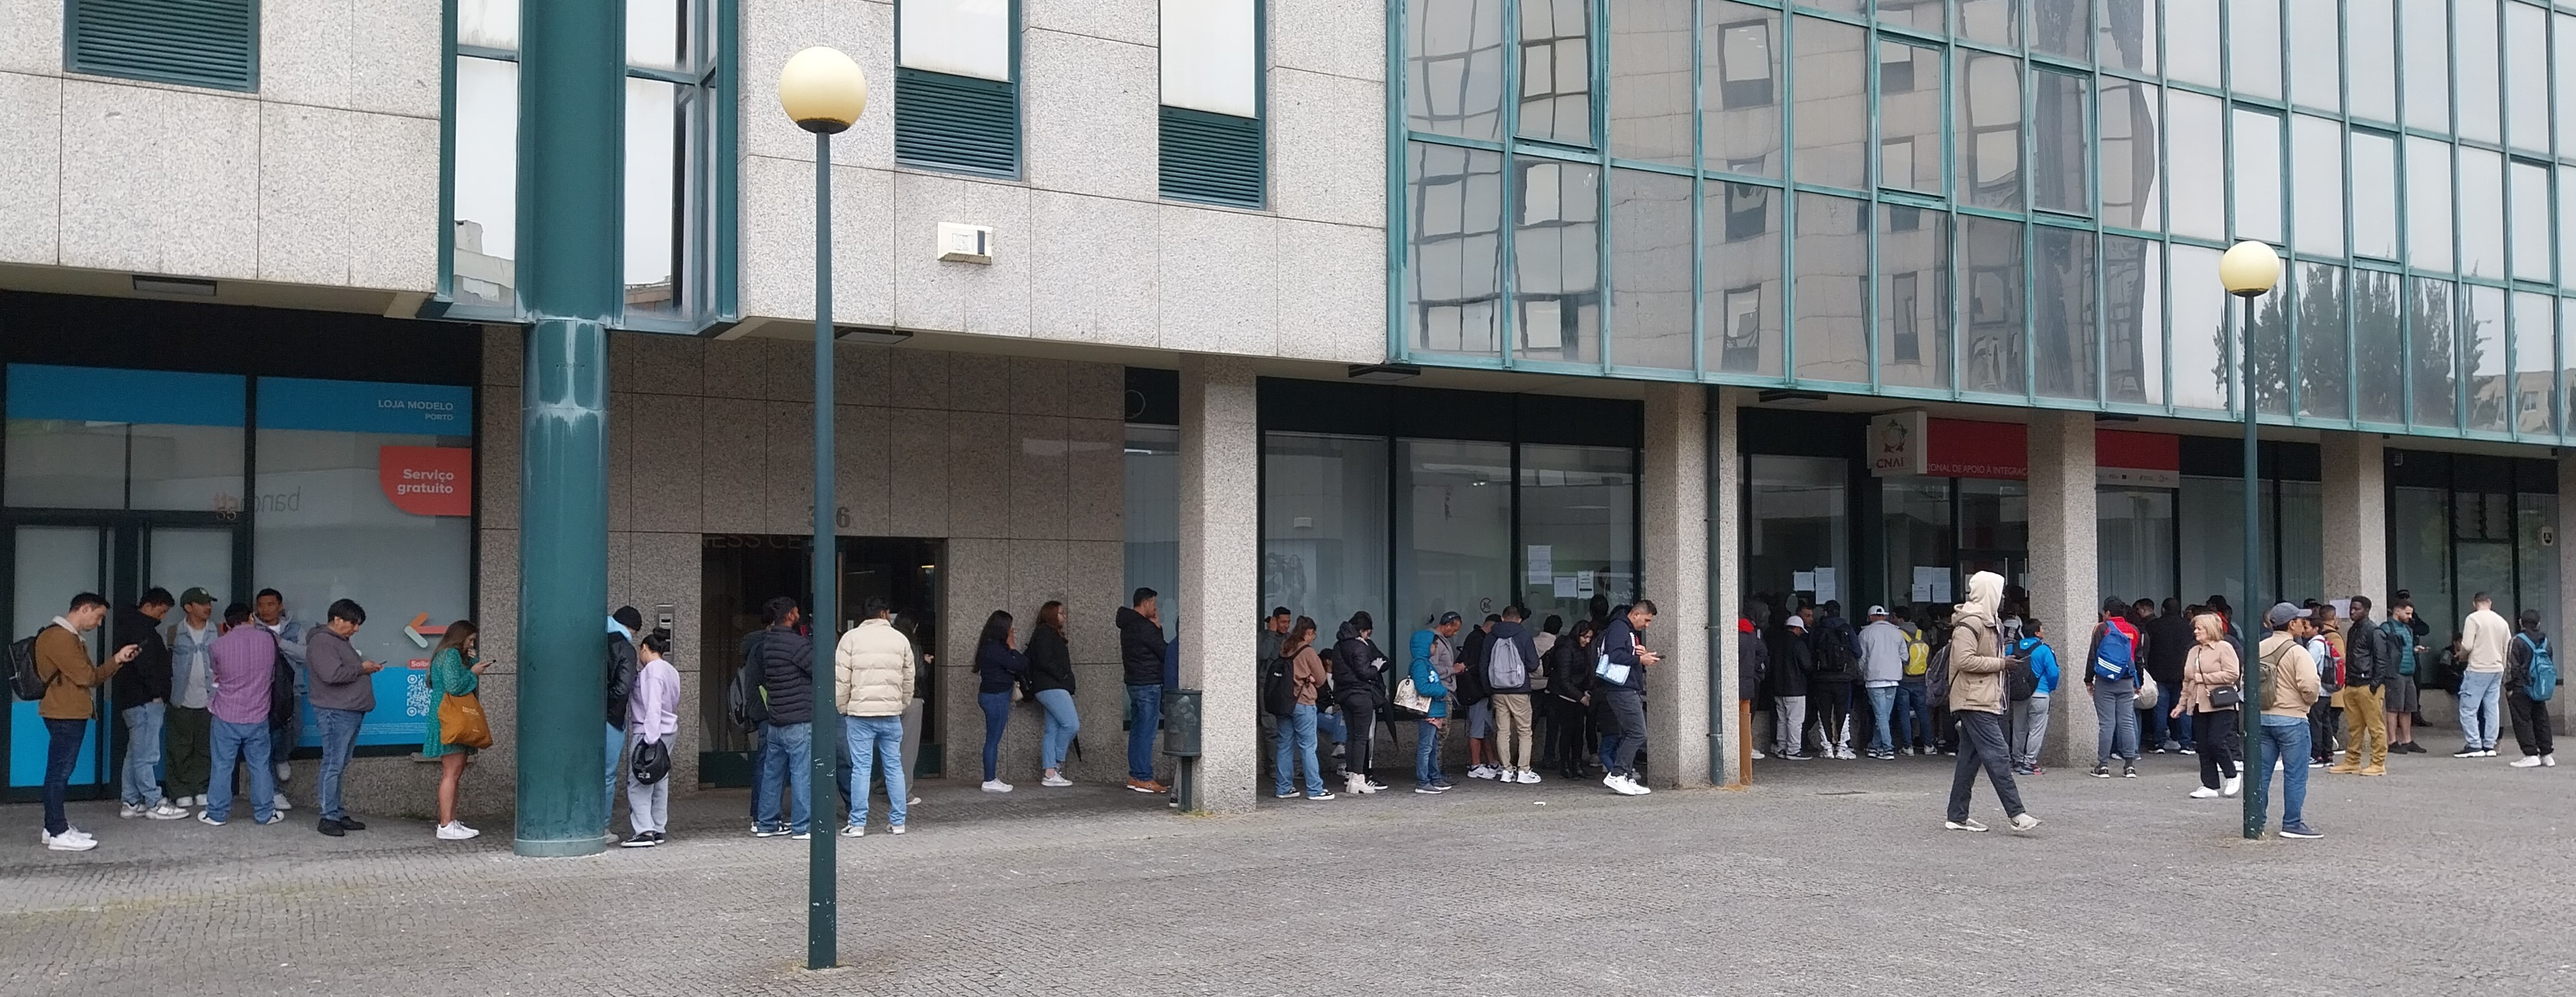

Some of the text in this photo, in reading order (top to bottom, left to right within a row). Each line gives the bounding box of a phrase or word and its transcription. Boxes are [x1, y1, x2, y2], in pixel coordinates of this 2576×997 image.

[378, 399, 454, 410] LOJA MODELO
[1927, 462, 1951, 472] IONAL
[1963, 465, 1985, 474] APOIO
[1993, 466, 2027, 476] INTEGRAÇ
[403, 469, 455, 483] Serviço
[397, 483, 454, 495] gratuito
